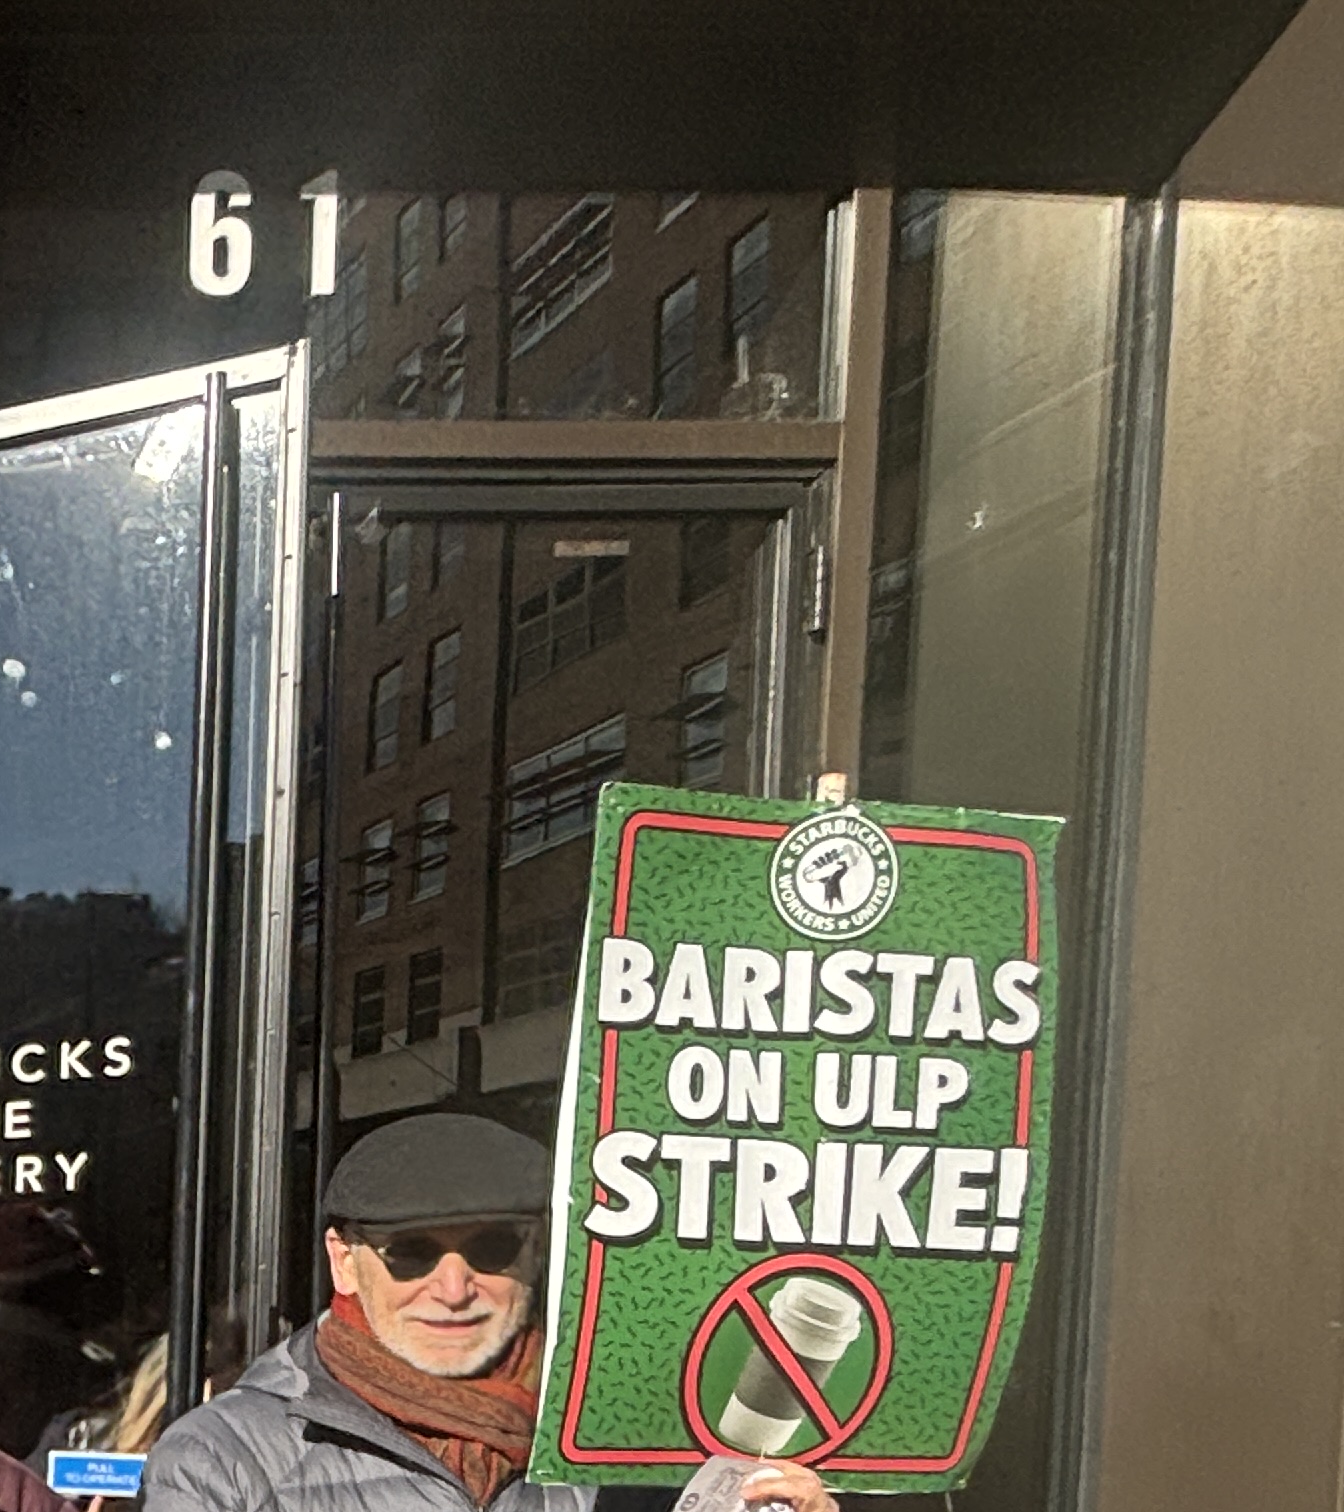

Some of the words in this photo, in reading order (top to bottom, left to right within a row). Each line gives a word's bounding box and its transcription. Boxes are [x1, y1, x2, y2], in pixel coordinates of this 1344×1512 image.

[789, 819, 886, 856] STARBUCKS
[778, 873, 835, 931] WORKERS
[851, 874, 890, 926] UNITED
[598, 937, 1041, 1045] BARISTAS
[667, 1046, 783, 1124] ON
[813, 1052, 970, 1130] ULP
[583, 1130, 1029, 1252] STRIKE!
